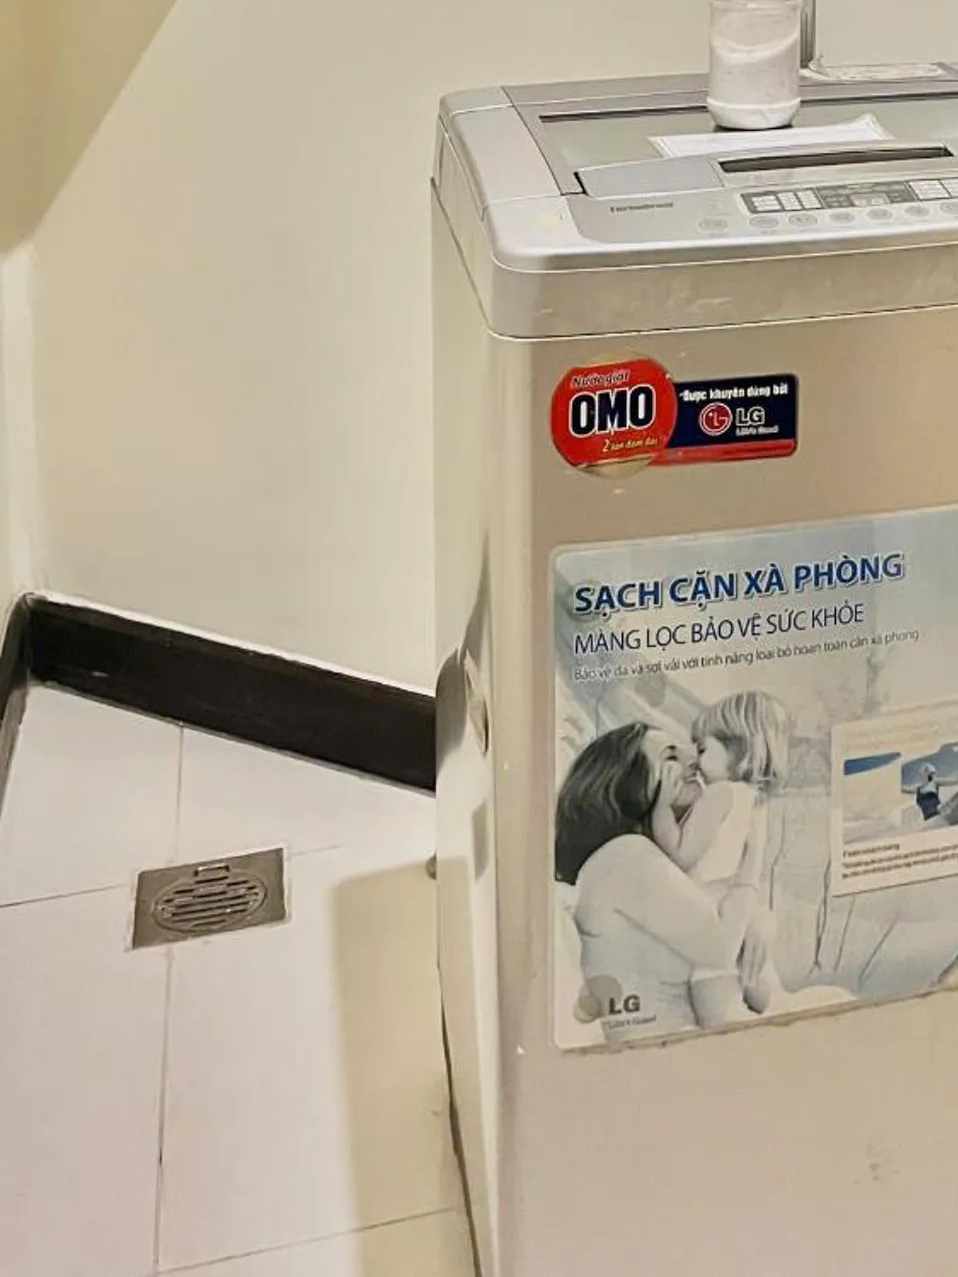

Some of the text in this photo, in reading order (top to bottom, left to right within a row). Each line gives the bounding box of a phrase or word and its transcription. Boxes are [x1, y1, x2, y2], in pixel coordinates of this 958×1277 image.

[568, 383, 657, 439] OMO
[735, 405, 766, 426] LG
[602, 438, 611, 452] 2
[574, 553, 904, 618] SẠCH CẶN XÀ PHÒNG
[575, 600, 865, 655] MÀNG LỌC BẢO VỆ SỨC KHỎE
[608, 994, 641, 1016] LG
